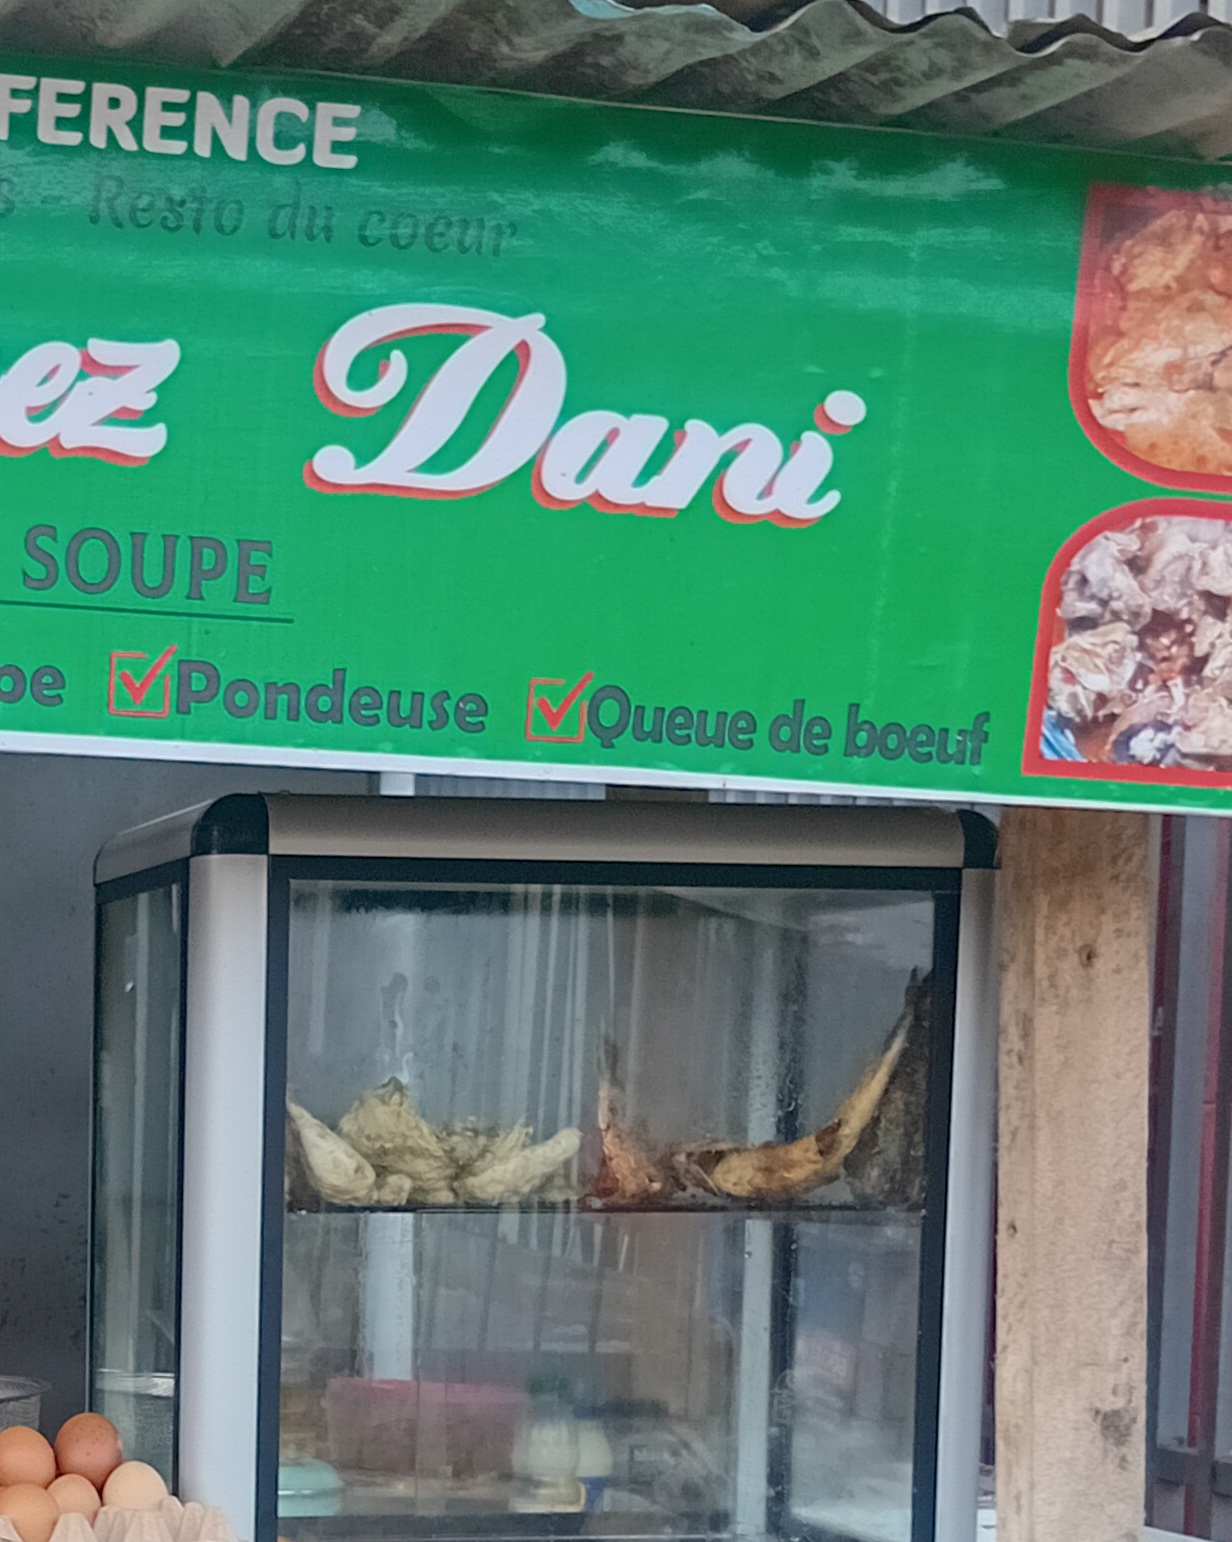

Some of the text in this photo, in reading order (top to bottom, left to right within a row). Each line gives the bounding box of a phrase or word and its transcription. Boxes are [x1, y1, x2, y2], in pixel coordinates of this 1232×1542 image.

[87, 172, 245, 237] Resto
[268, 175, 334, 244] du
[358, 208, 519, 258] coeur
[302, 303, 867, 529] Dani
[22, 523, 274, 606] SOUPE
[174, 658, 489, 734] Pondeuse
[586, 684, 758, 751] Queue
[768, 699, 833, 757] de
[842, 702, 992, 766] boeuf
